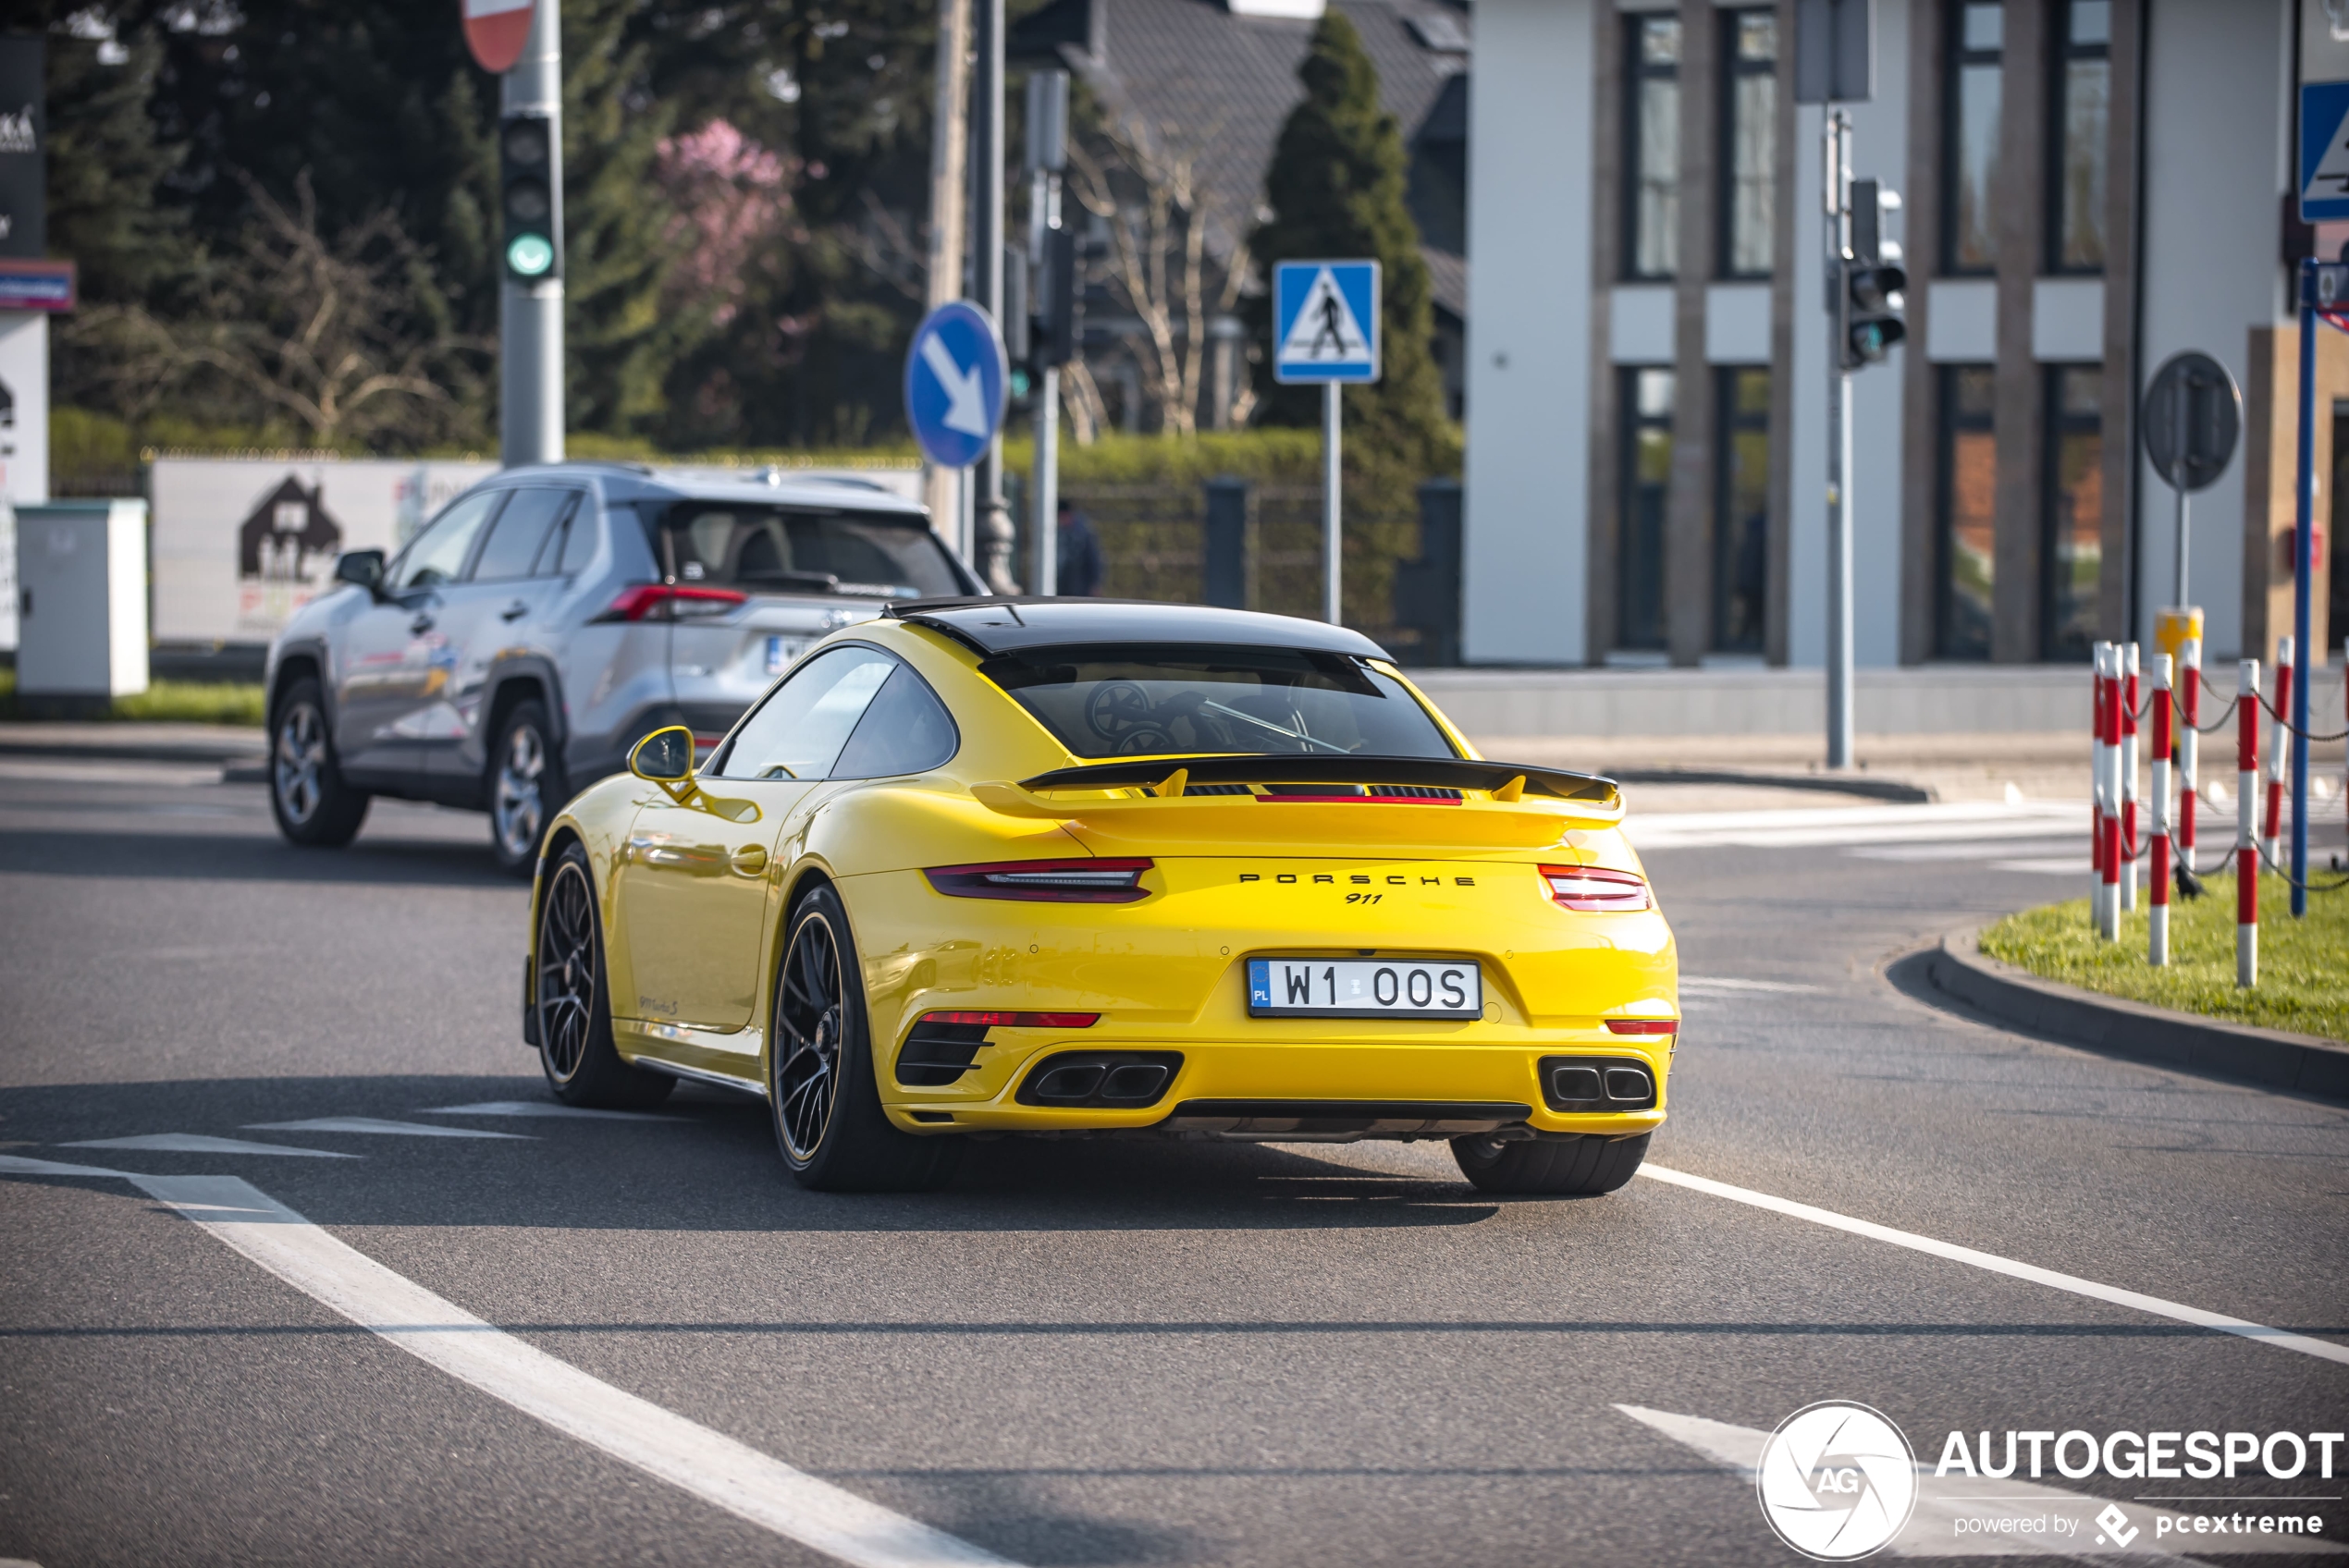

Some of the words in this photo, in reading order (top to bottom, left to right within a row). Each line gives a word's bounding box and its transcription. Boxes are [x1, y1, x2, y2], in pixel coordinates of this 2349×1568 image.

[1239, 873, 1476, 887] PORSCHE
[1345, 892, 1384, 905] 911
[1285, 965, 1336, 1006] W1
[1253, 990, 1269, 1001] PL
